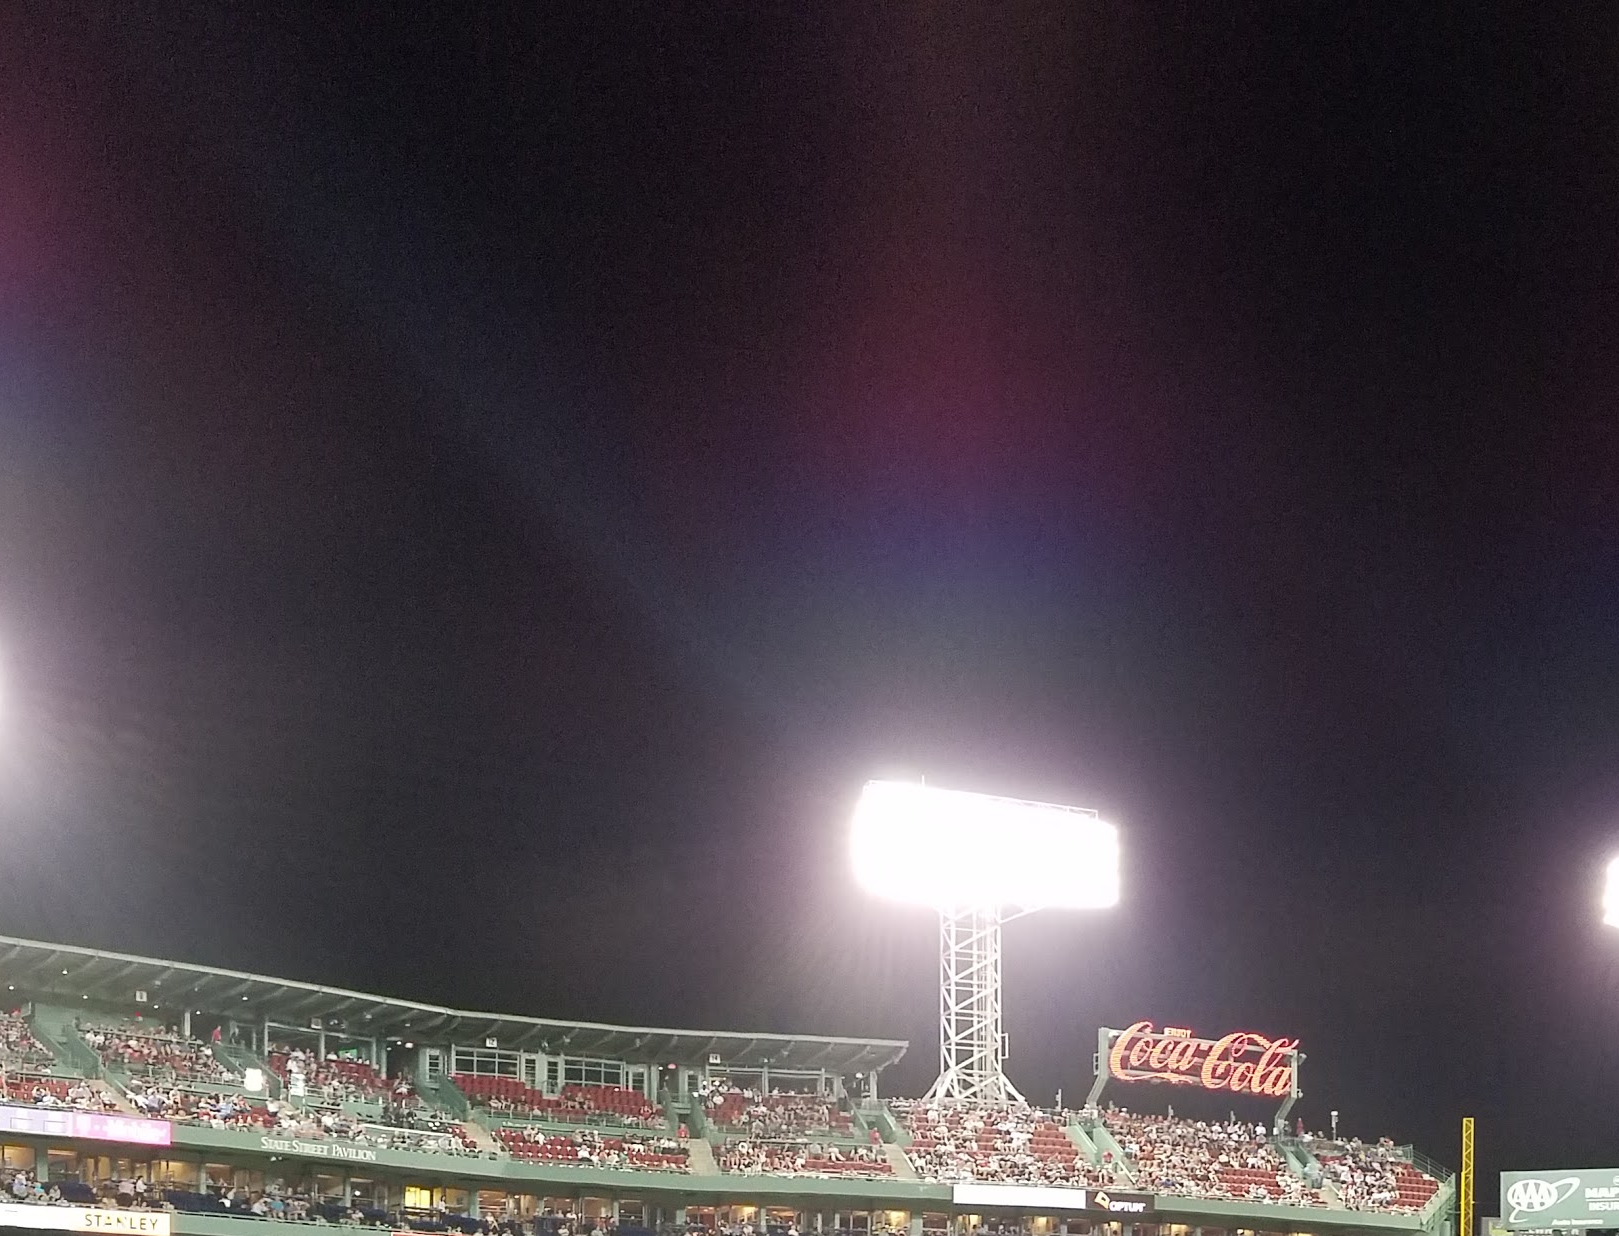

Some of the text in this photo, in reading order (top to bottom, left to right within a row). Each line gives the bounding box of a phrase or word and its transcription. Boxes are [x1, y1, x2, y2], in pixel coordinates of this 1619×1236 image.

[261, 1137, 377, 1161] STATE STREET PAVILION
[1513, 1182, 1552, 1201] AAA
[1109, 1200, 1147, 1212] OPTUM
[85, 1213, 159, 1231] STANLEY
